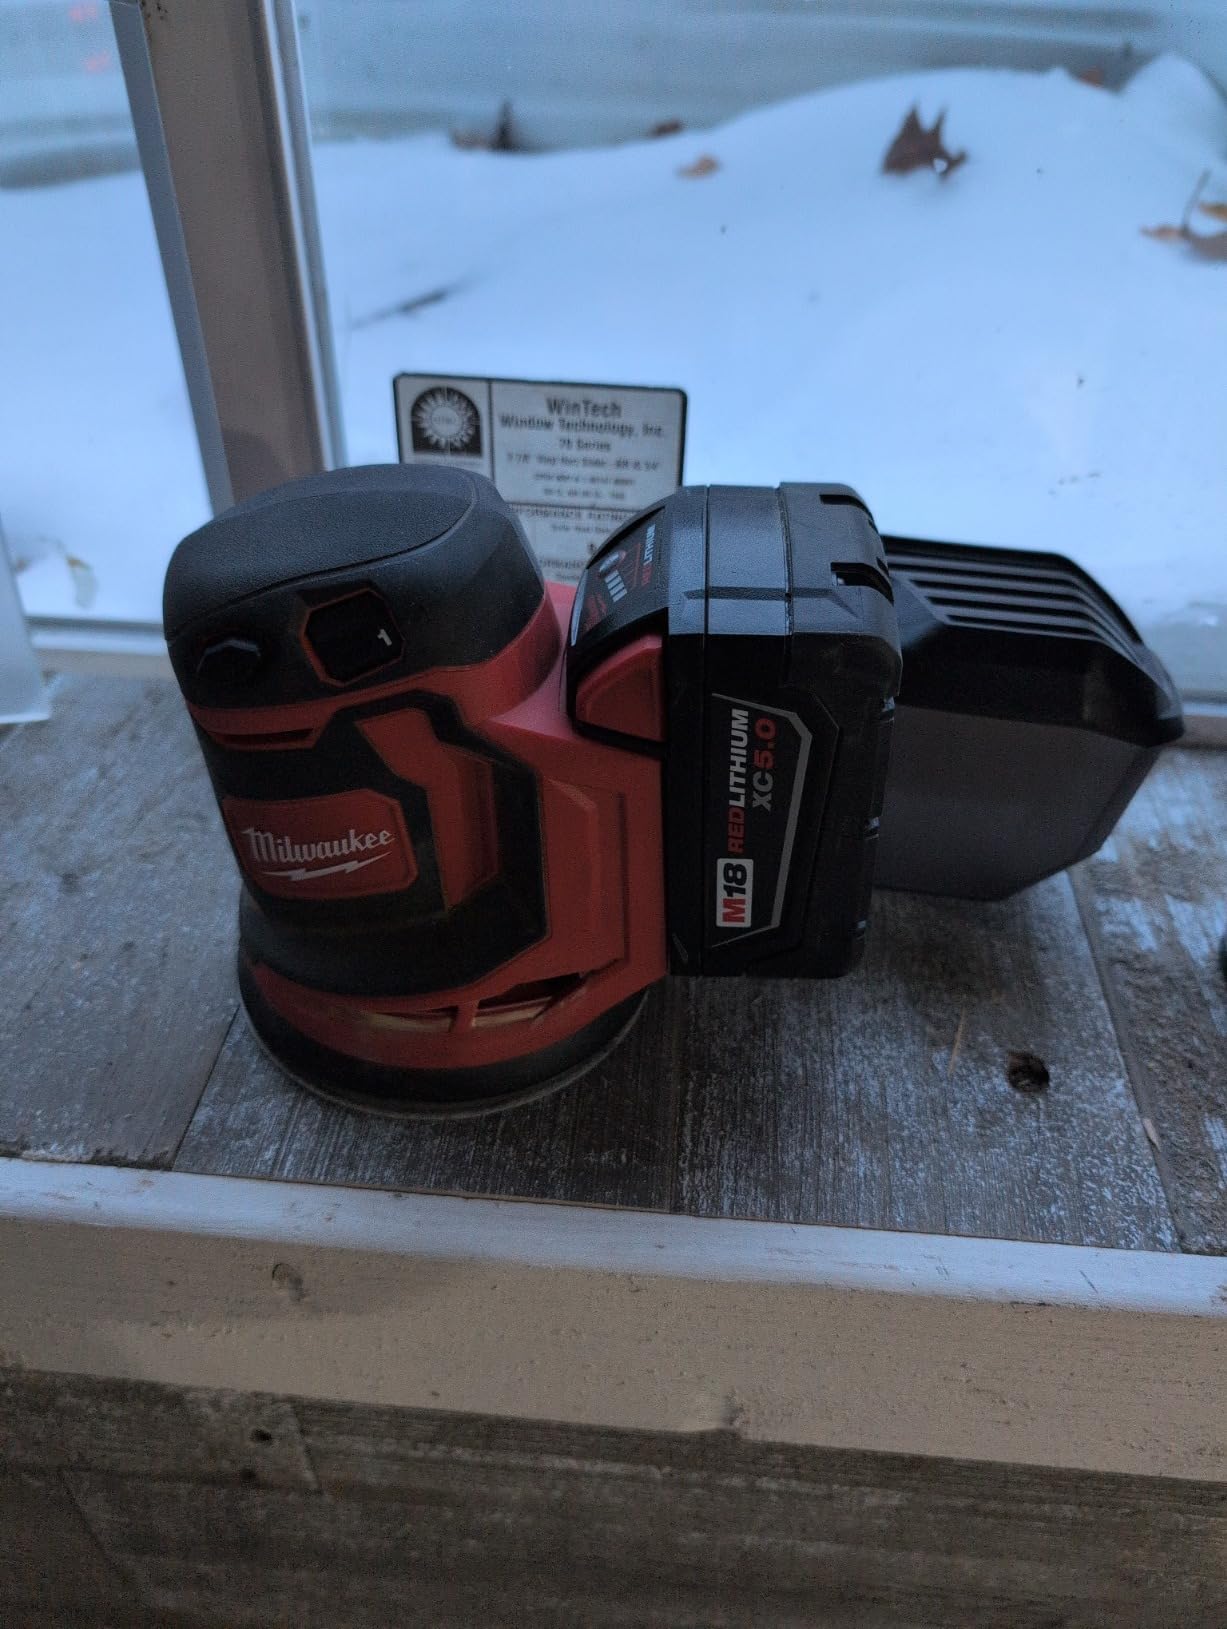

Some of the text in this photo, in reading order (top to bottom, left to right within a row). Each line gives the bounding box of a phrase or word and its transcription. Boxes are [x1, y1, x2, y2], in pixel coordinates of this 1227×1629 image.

[547, 397, 622, 418] WinTech
[376, 628, 393, 647] 1
[752, 716, 778, 812] XC5.0
[722, 708, 749, 924] M18 REDLITHIUM
[241, 826, 396, 864] Milwaukee
